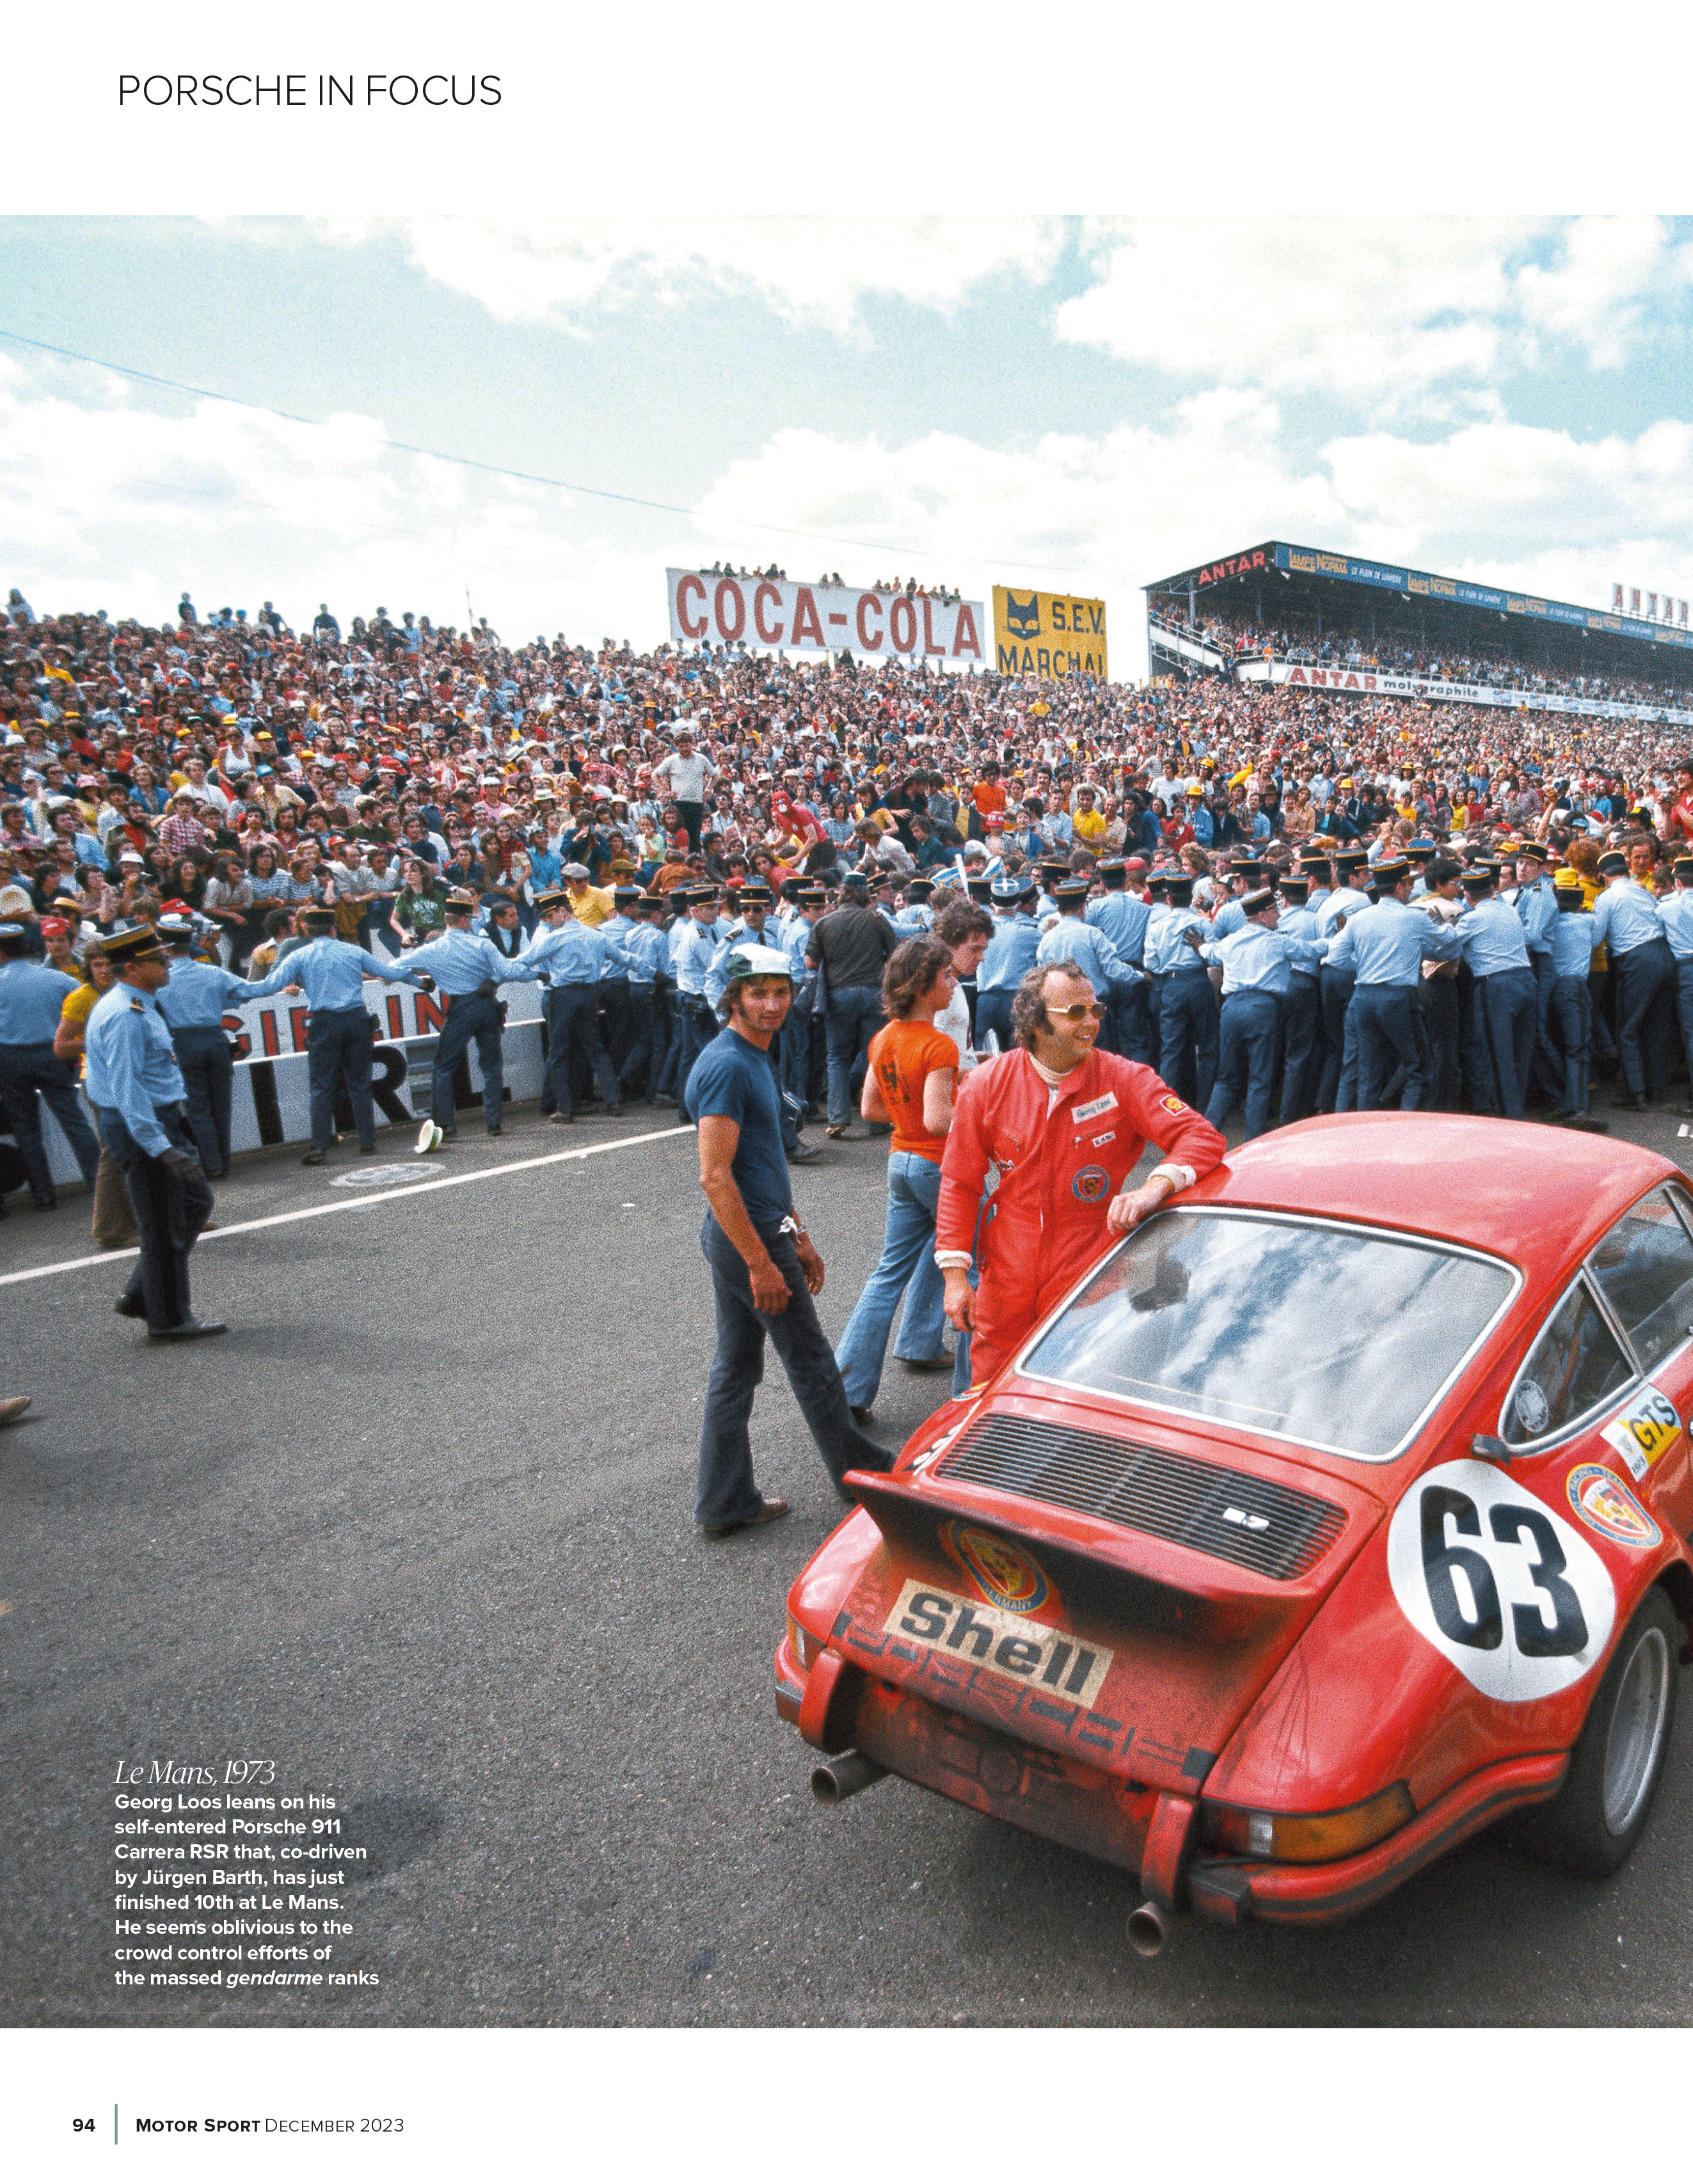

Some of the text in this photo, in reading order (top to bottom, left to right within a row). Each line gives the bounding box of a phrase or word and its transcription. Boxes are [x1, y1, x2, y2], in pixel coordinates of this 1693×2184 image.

[1198, 551, 1265, 585] ANTAR
[676, 574, 982, 659] COCA-COLA
[1052, 601, 1105, 635] S.E.V.
[1614, 584, 1689, 622] ANTAR
[1288, 667, 1378, 692] ANTAR
[1630, 1395, 1676, 1451] GTS
[1420, 1485, 1589, 1658] 63
[900, 1592, 1097, 1696] Shell
